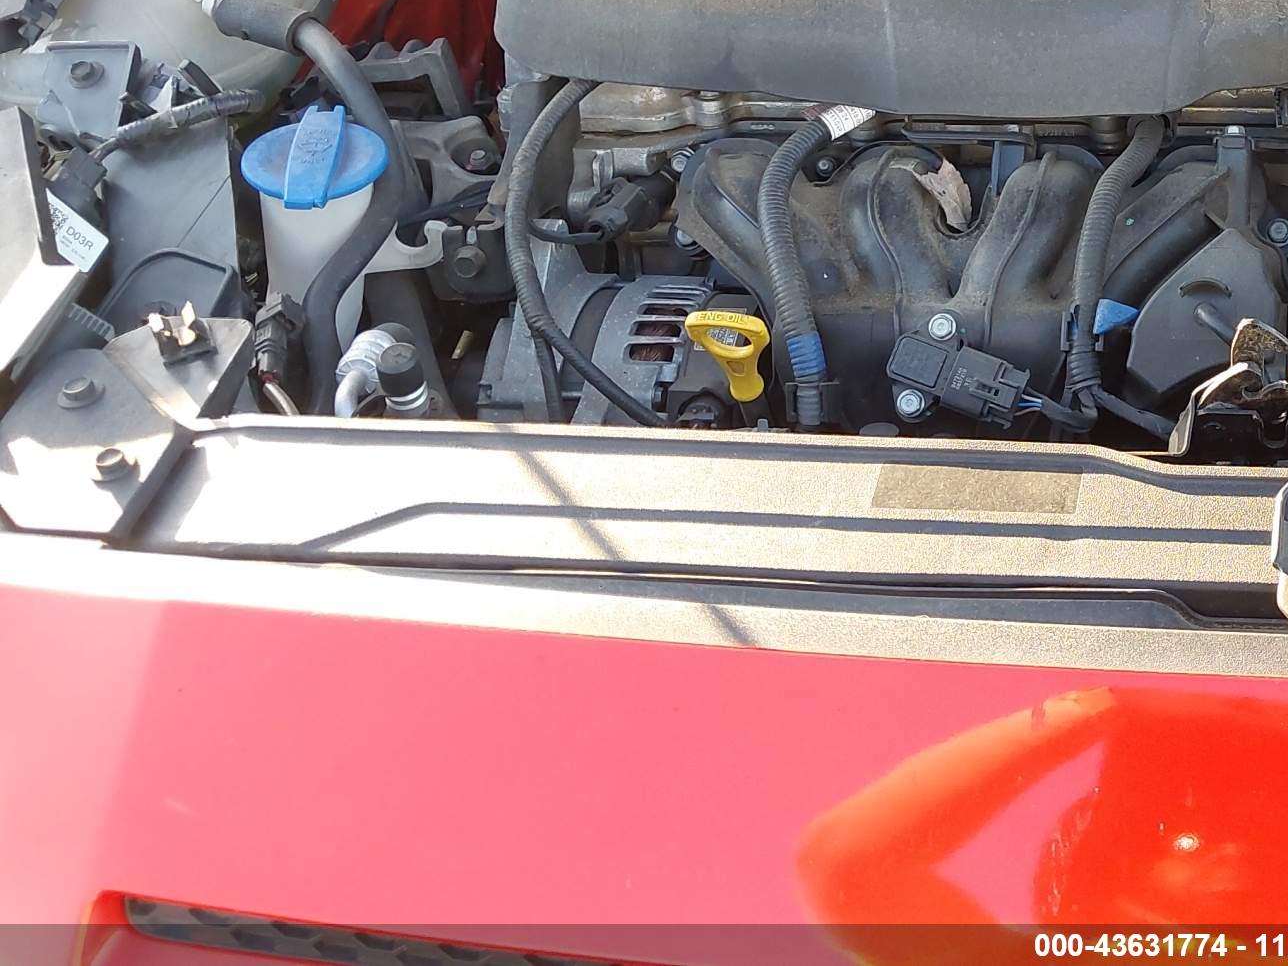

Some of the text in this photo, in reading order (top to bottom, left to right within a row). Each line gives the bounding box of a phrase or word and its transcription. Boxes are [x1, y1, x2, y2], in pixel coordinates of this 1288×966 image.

[65, 225, 94, 251] D03R
[697, 312, 746, 324] ENG OIL
